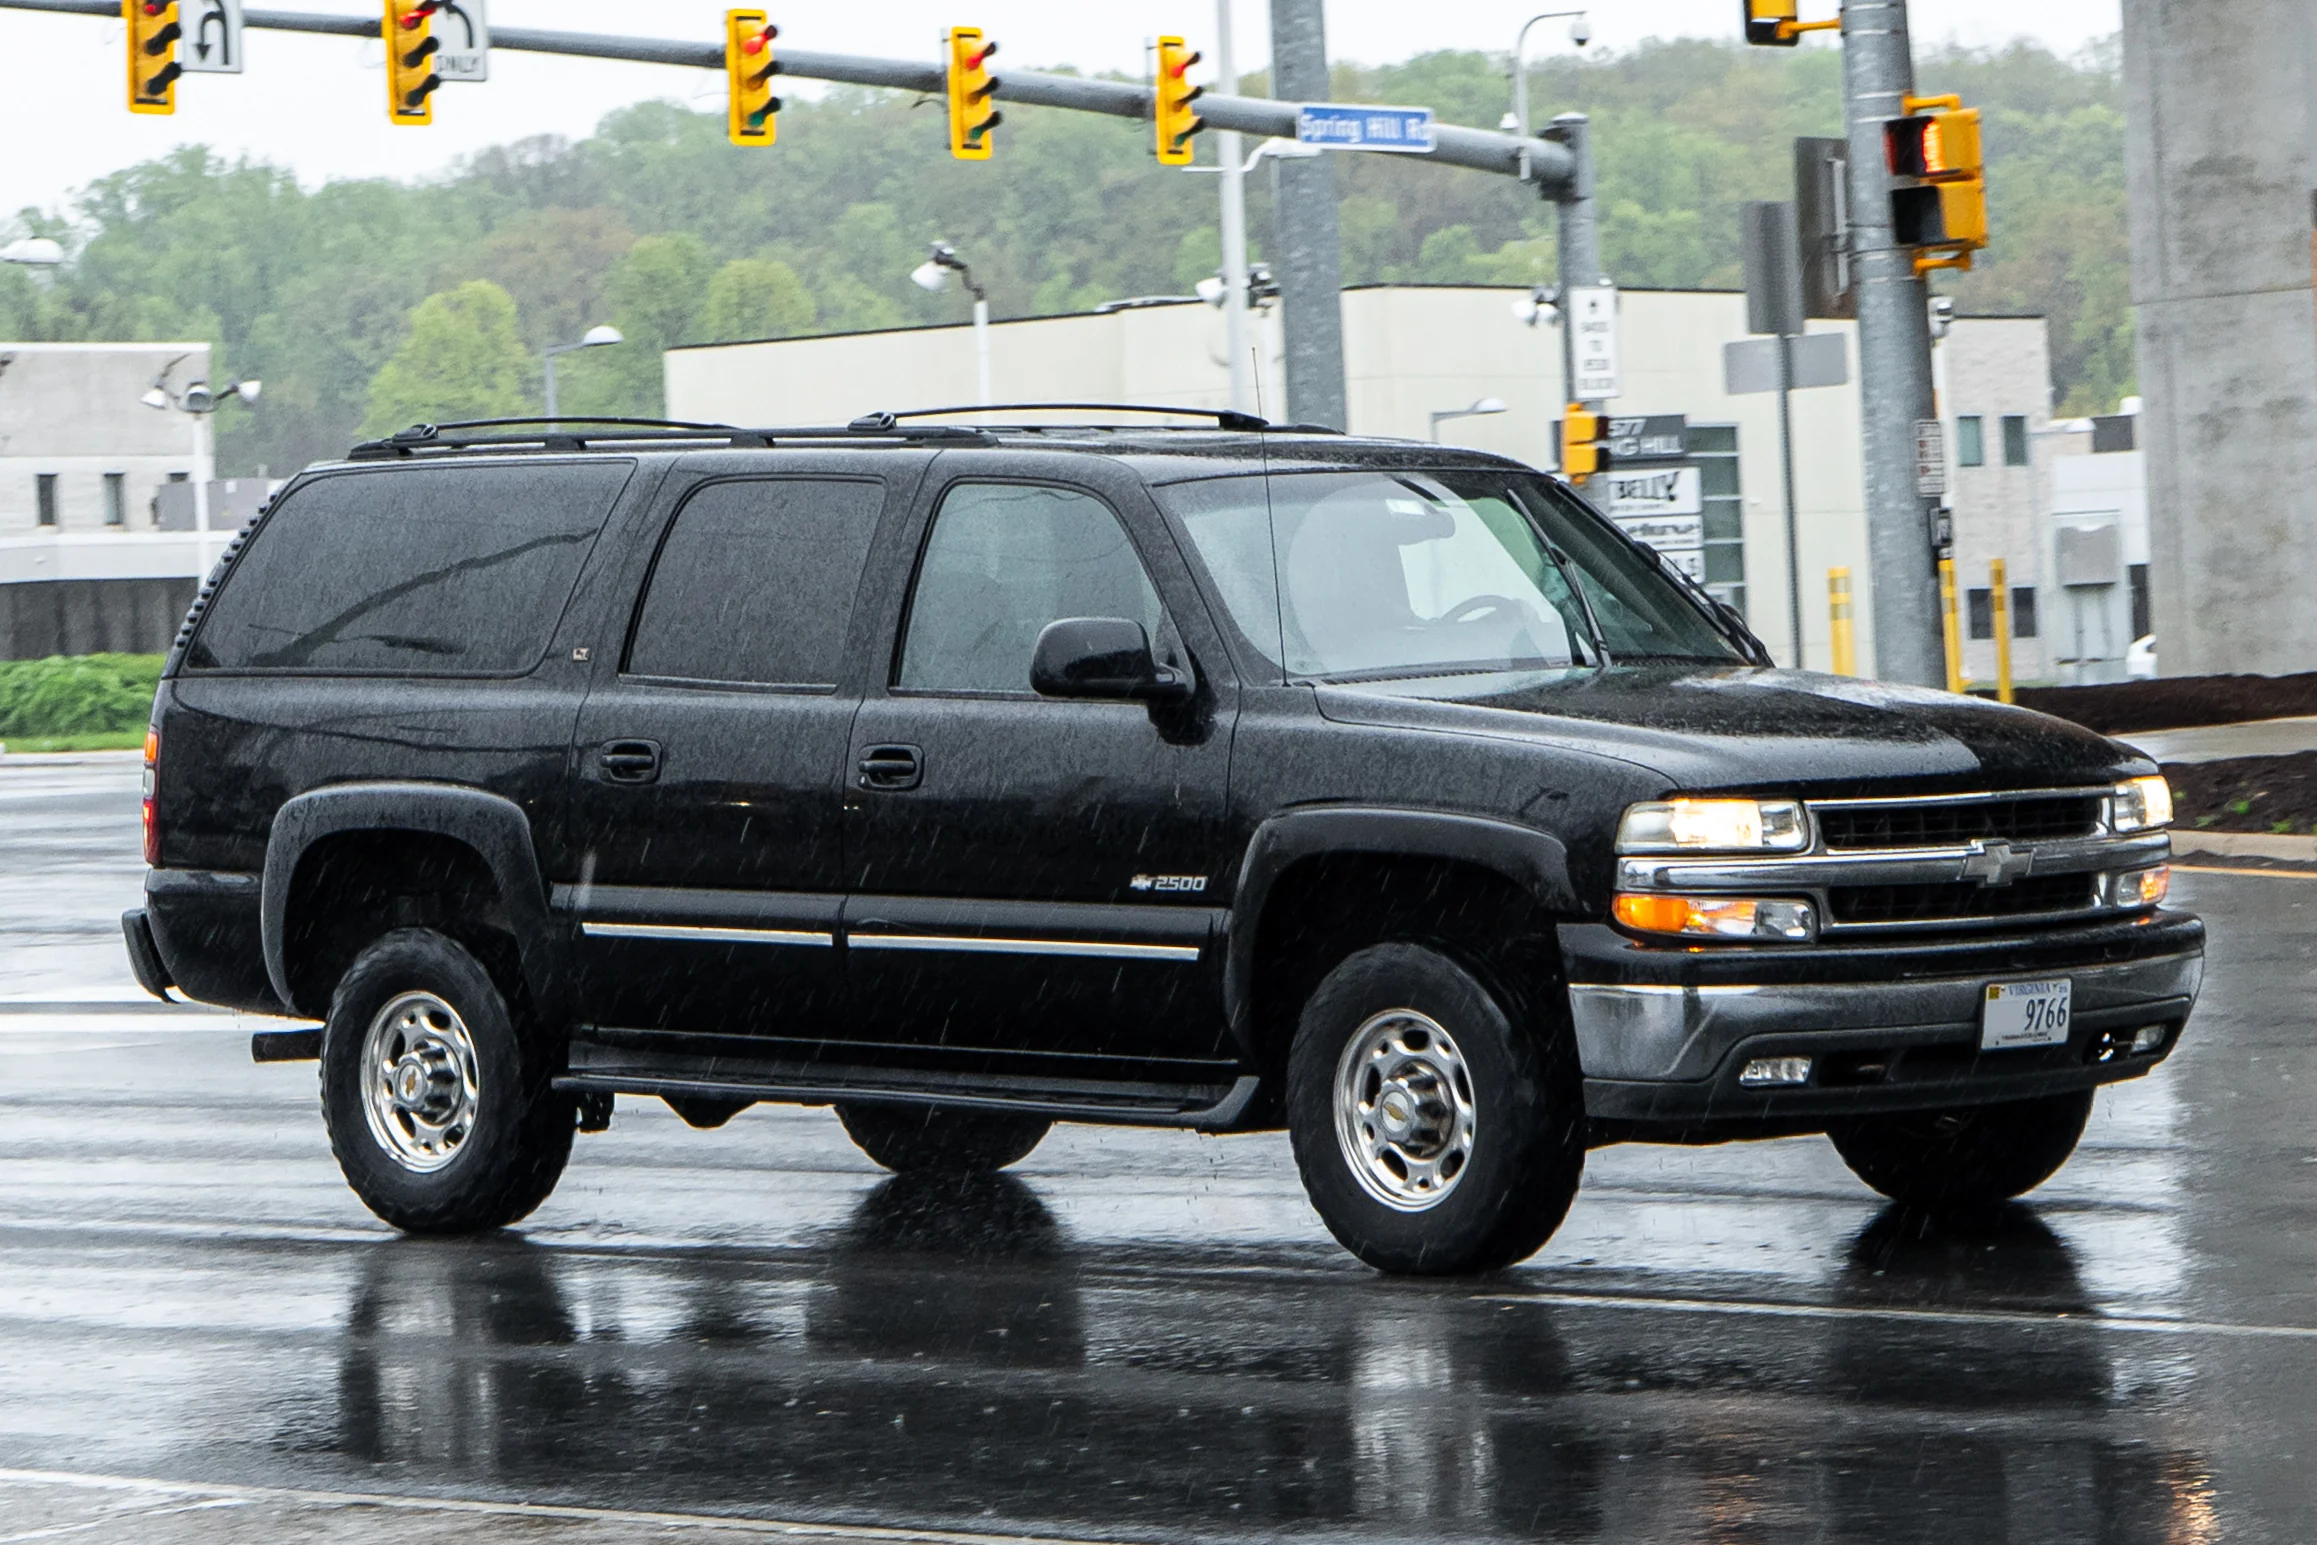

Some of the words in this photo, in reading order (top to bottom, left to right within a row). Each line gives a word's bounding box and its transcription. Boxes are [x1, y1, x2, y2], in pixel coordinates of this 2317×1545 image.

[436, 55, 479, 73] ONLY
[1300, 113, 1361, 143] Spring
[1365, 117, 1402, 139] Hill
[1640, 434, 1684, 455] HILL
[1155, 875, 1208, 891] 2500
[2008, 983, 2051, 996] VIRGINIA
[2025, 997, 2067, 1031] 9766
